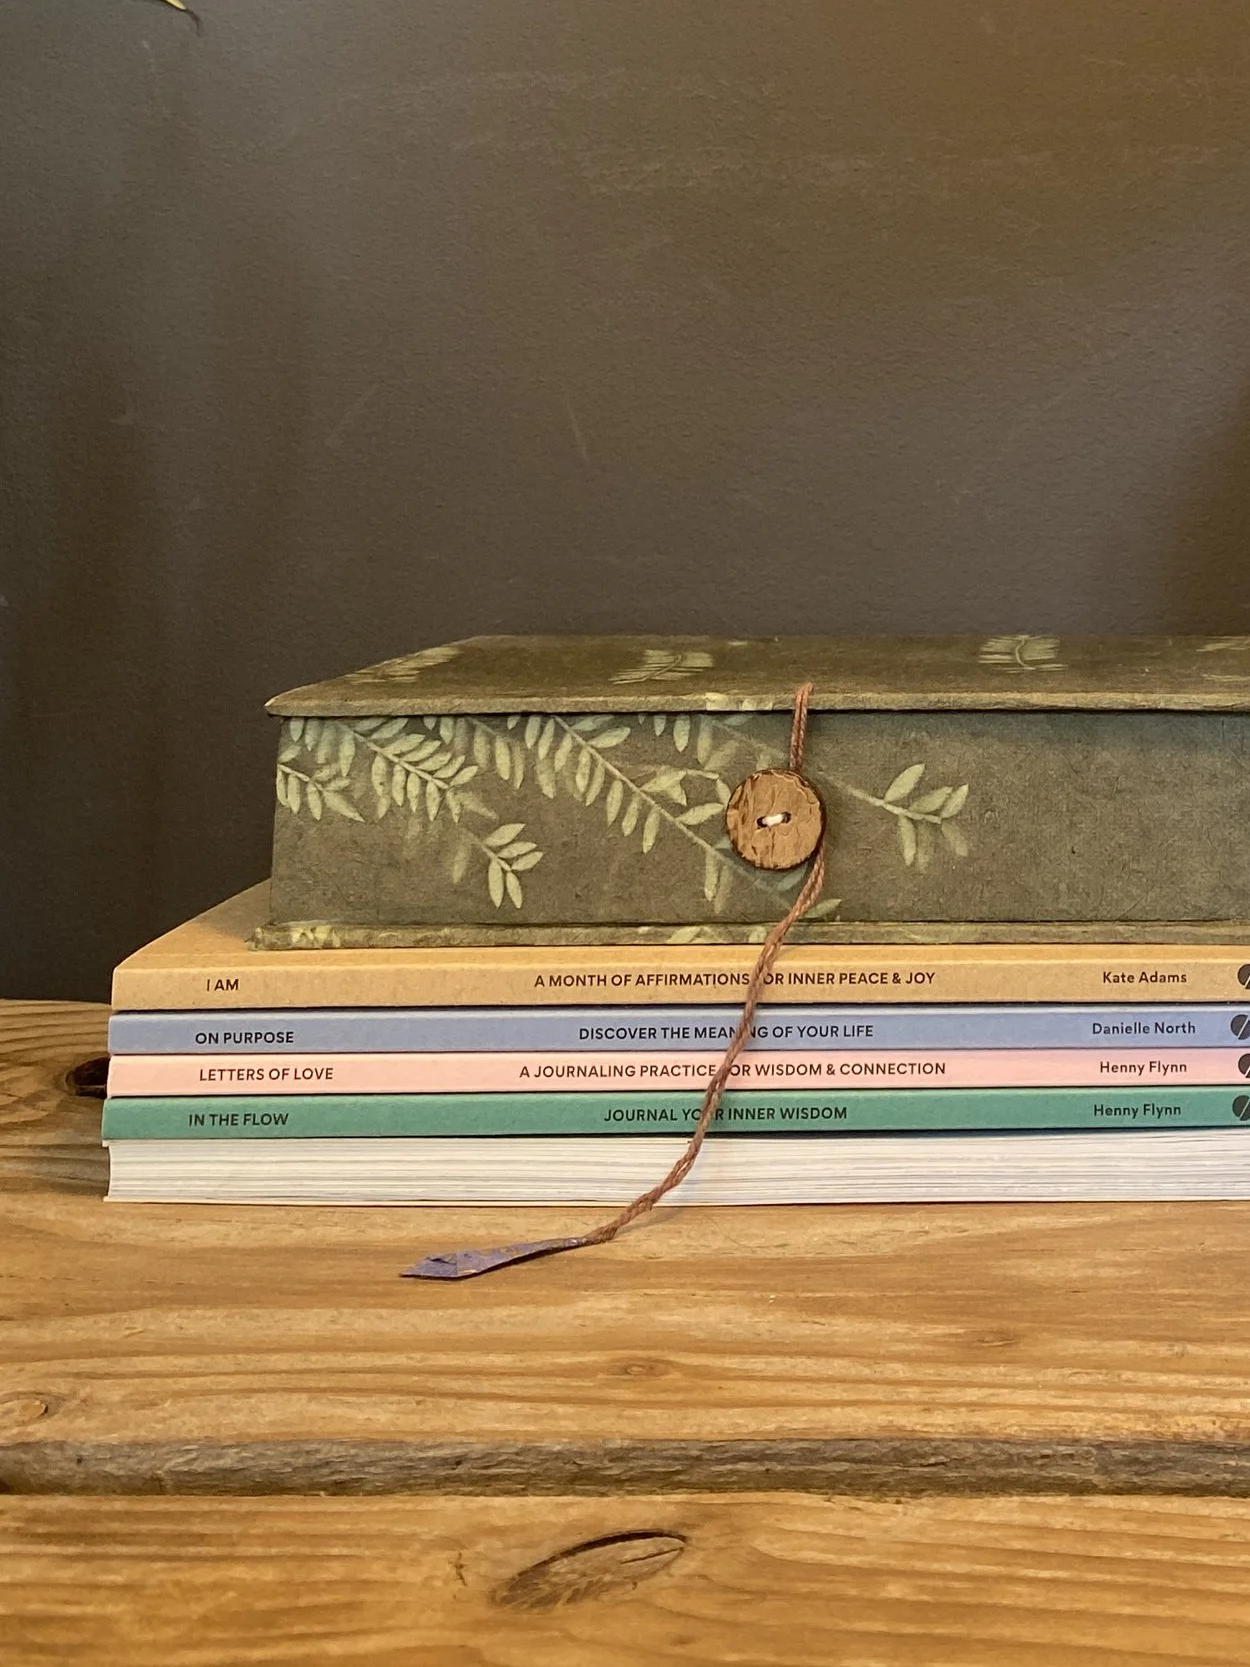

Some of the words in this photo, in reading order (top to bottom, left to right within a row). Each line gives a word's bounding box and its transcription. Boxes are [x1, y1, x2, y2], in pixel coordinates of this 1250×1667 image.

[534, 974, 546, 988] A
[549, 974, 607, 987] MONTH
[610, 973, 633, 987] OF
[634, 972, 750, 986] AFFIRMATIONS
[759, 972, 784, 985] OR
[788, 972, 835, 985] INNER
[838, 972, 889, 985] PEACE
[891, 972, 902, 985] &
[905, 971, 936, 985] JOY
[1102, 971, 1135, 984] Kate
[1138, 970, 1187, 984] Adams
[206, 978, 211, 992] I
[213, 978, 239, 992] AM
[579, 1027, 657, 1040] DISCOVER
[660, 1026, 690, 1040] THE
[694, 1026, 769, 1039] MEANNG
[772, 1025, 794, 1039] OF
[796, 1025, 839, 1038] YOUR
[843, 1024, 874, 1038] LIFE
[1092, 1021, 1151, 1035] Danielle
[1154, 1021, 1196, 1034] North
[195, 1032, 219, 1045] ON
[223, 1031, 294, 1044] PURPOSE
[199, 1068, 265, 1082] LETTERS
[268, 1067, 291, 1081] OF
[293, 1067, 334, 1081] LOVE
[519, 1065, 531, 1079] A
[533, 1065, 636, 1078] JOURNALING
[640, 1064, 716, 1077] PRACTICE
[726, 1064, 751, 1077] OR
[754, 1063, 822, 1077] WISDOM
[826, 1063, 836, 1076] &
[839, 1062, 946, 1076] CONNECTION
[1099, 1061, 1146, 1077] Henny
[1149, 1060, 1187, 1077] Flynn
[603, 1108, 678, 1122] JOURNAL
[682, 1108, 724, 1121] YOR
[728, 1107, 776, 1121] INNER
[779, 1106, 847, 1120] WISDOM
[1093, 1103, 1139, 1120] Henny
[1143, 1102, 1182, 1120] Flynn
[188, 1113, 206, 1127] IN
[208, 1113, 240, 1127] THE
[243, 1112, 289, 1126] FLOW
